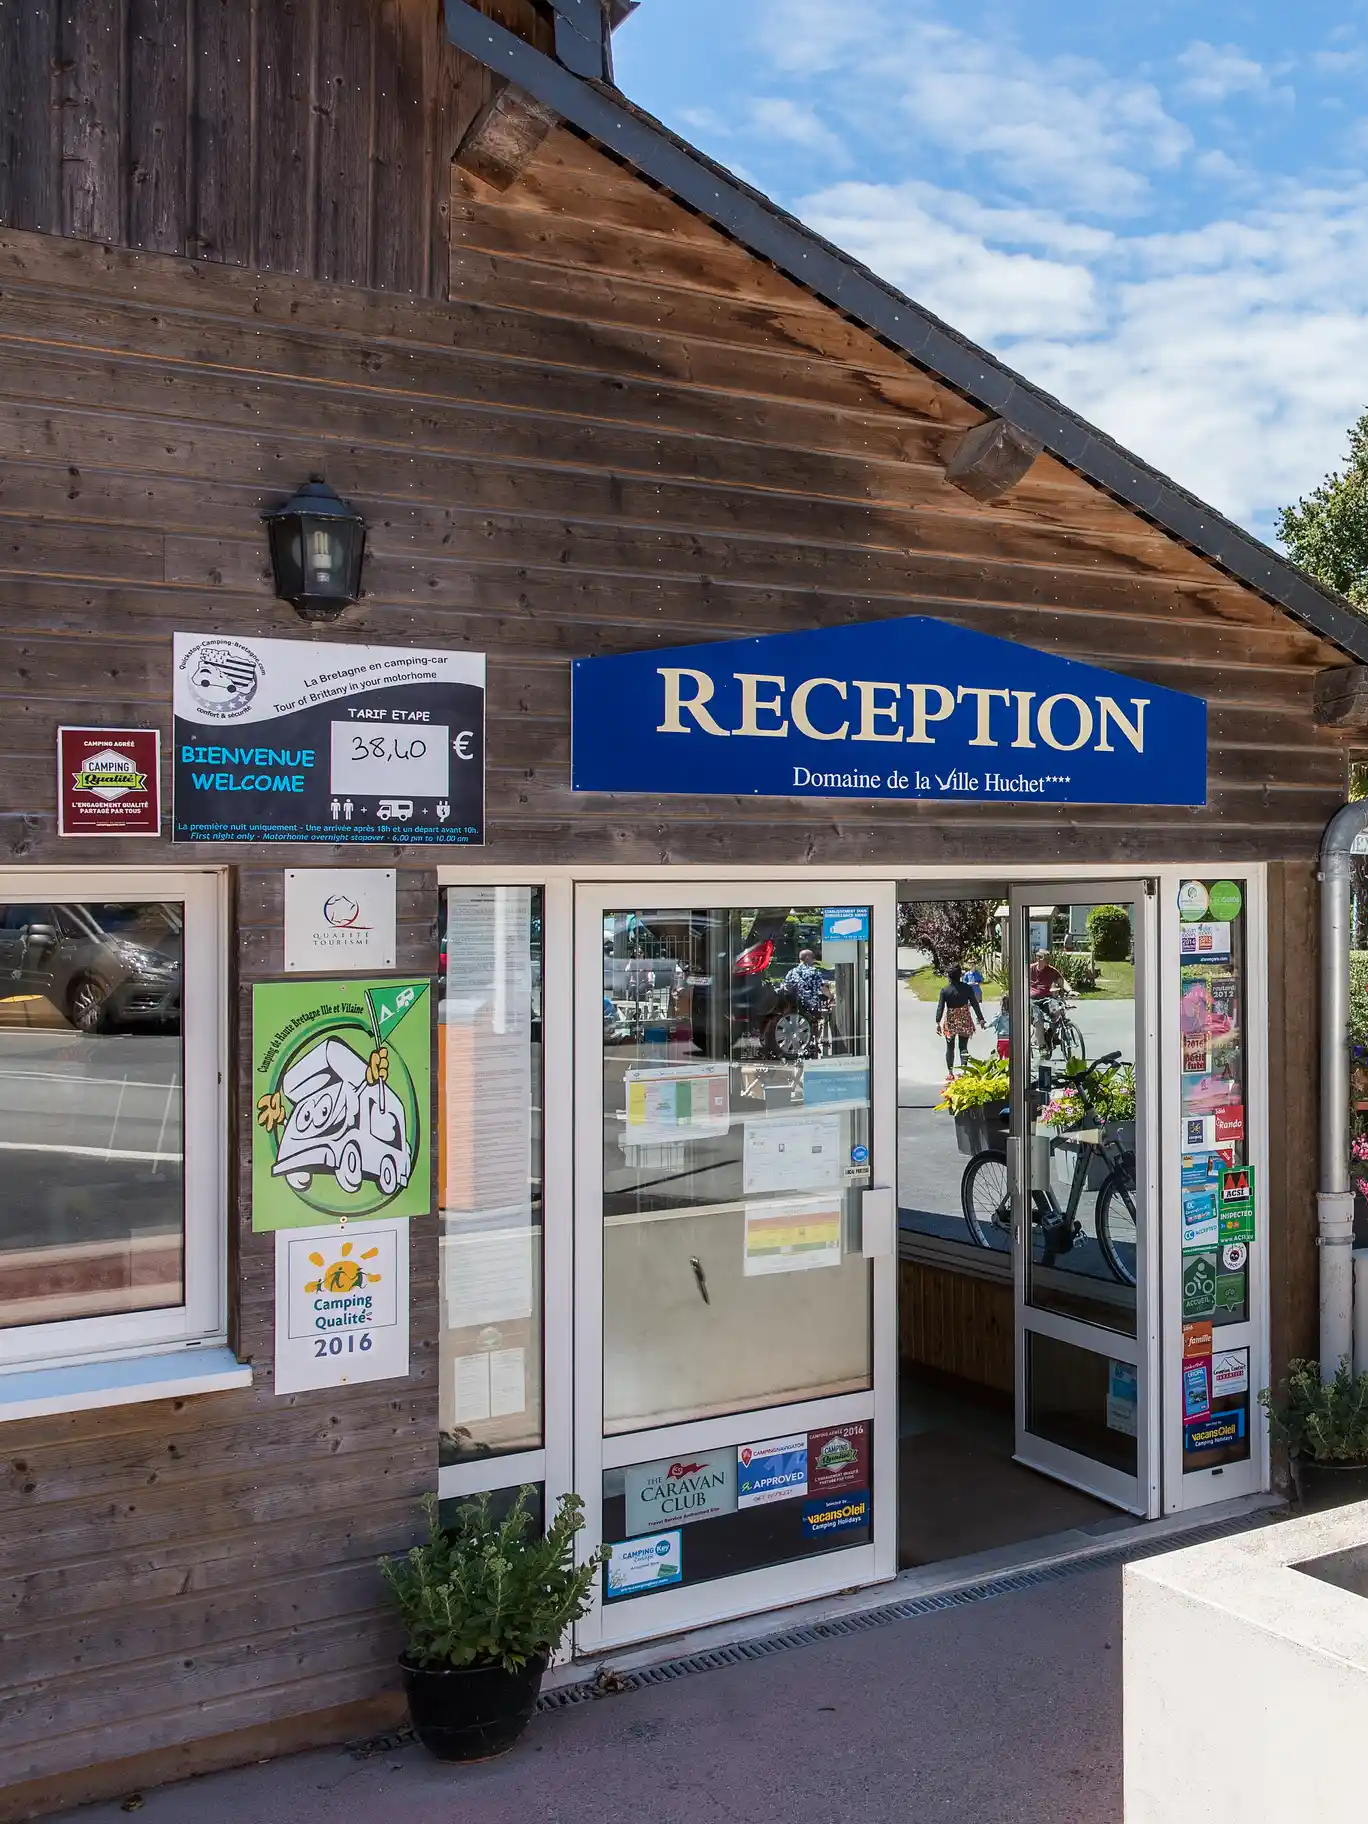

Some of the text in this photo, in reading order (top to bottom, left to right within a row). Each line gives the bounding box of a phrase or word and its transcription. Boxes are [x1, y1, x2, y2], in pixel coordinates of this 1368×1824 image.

[304, 656, 448, 688] La Bretagne en camping-car
[273, 671, 437, 713] Tour of Brittany in your motorhome
[196, 707, 220, 719] confort
[227, 705, 252, 718] sécurité
[348, 708, 430, 722] TARIF ETAPE
[656, 667, 1150, 753] RECEPTION
[113, 740, 135, 748] AGRÉÉ
[351, 736, 427, 762] 38,40
[452, 730, 474, 760] €
[181, 745, 316, 768] BIENVENUE
[89, 762, 129, 772] CAMPING
[84, 774, 134, 785] Qualité
[191, 772, 305, 793] WELCOME
[793, 766, 881, 788] Domaine
[887, 771, 909, 790] de
[915, 771, 931, 789] la
[935, 767, 979, 791] Ville
[178, 822, 188, 831] La
[190, 822, 228, 832] première
[230, 823, 247, 831] nuit
[249, 823, 298, 832] uniquement
[353, 825, 375, 834] après
[414, 825, 439, 835] départ
[190, 832, 210, 840] First
[212, 832, 235, 841] night
[236, 832, 255, 841] only
[310, 834, 348, 843] overnight
[333, 1003, 341, 1013] et
[341, 1003, 364, 1015] Vilaine
[290, 1008, 321, 1028] Bretagne
[275, 1024, 295, 1042] Haute
[273, 1038, 282, 1048] de
[257, 1046, 280, 1073] Camping
[1219, 1119, 1243, 1129] Rando
[1220, 1210, 1252, 1220] INSPECTED
[314, 1294, 373, 1311] Camping
[1186, 1297, 1210, 1308] ACCUEIL
[315, 1309, 366, 1330] Qualité
[314, 1332, 373, 1358] 2016
[1188, 1334, 1212, 1347] famille
[843, 1425, 864, 1437] 2016
[824, 1443, 848, 1453] CAMPING
[1194, 1438, 1214, 1447] Camping
[640, 1471, 725, 1502] CARAVAN
[648, 1477, 663, 1486] THE
[753, 1471, 804, 1490] APPROVED
[661, 1492, 706, 1514] CLUB
[807, 1502, 865, 1525] vacansOleil
[648, 1519, 664, 1527] Travel
[812, 1516, 862, 1531] Camping Holidays
[622, 1544, 670, 1560] CAMPING Key
